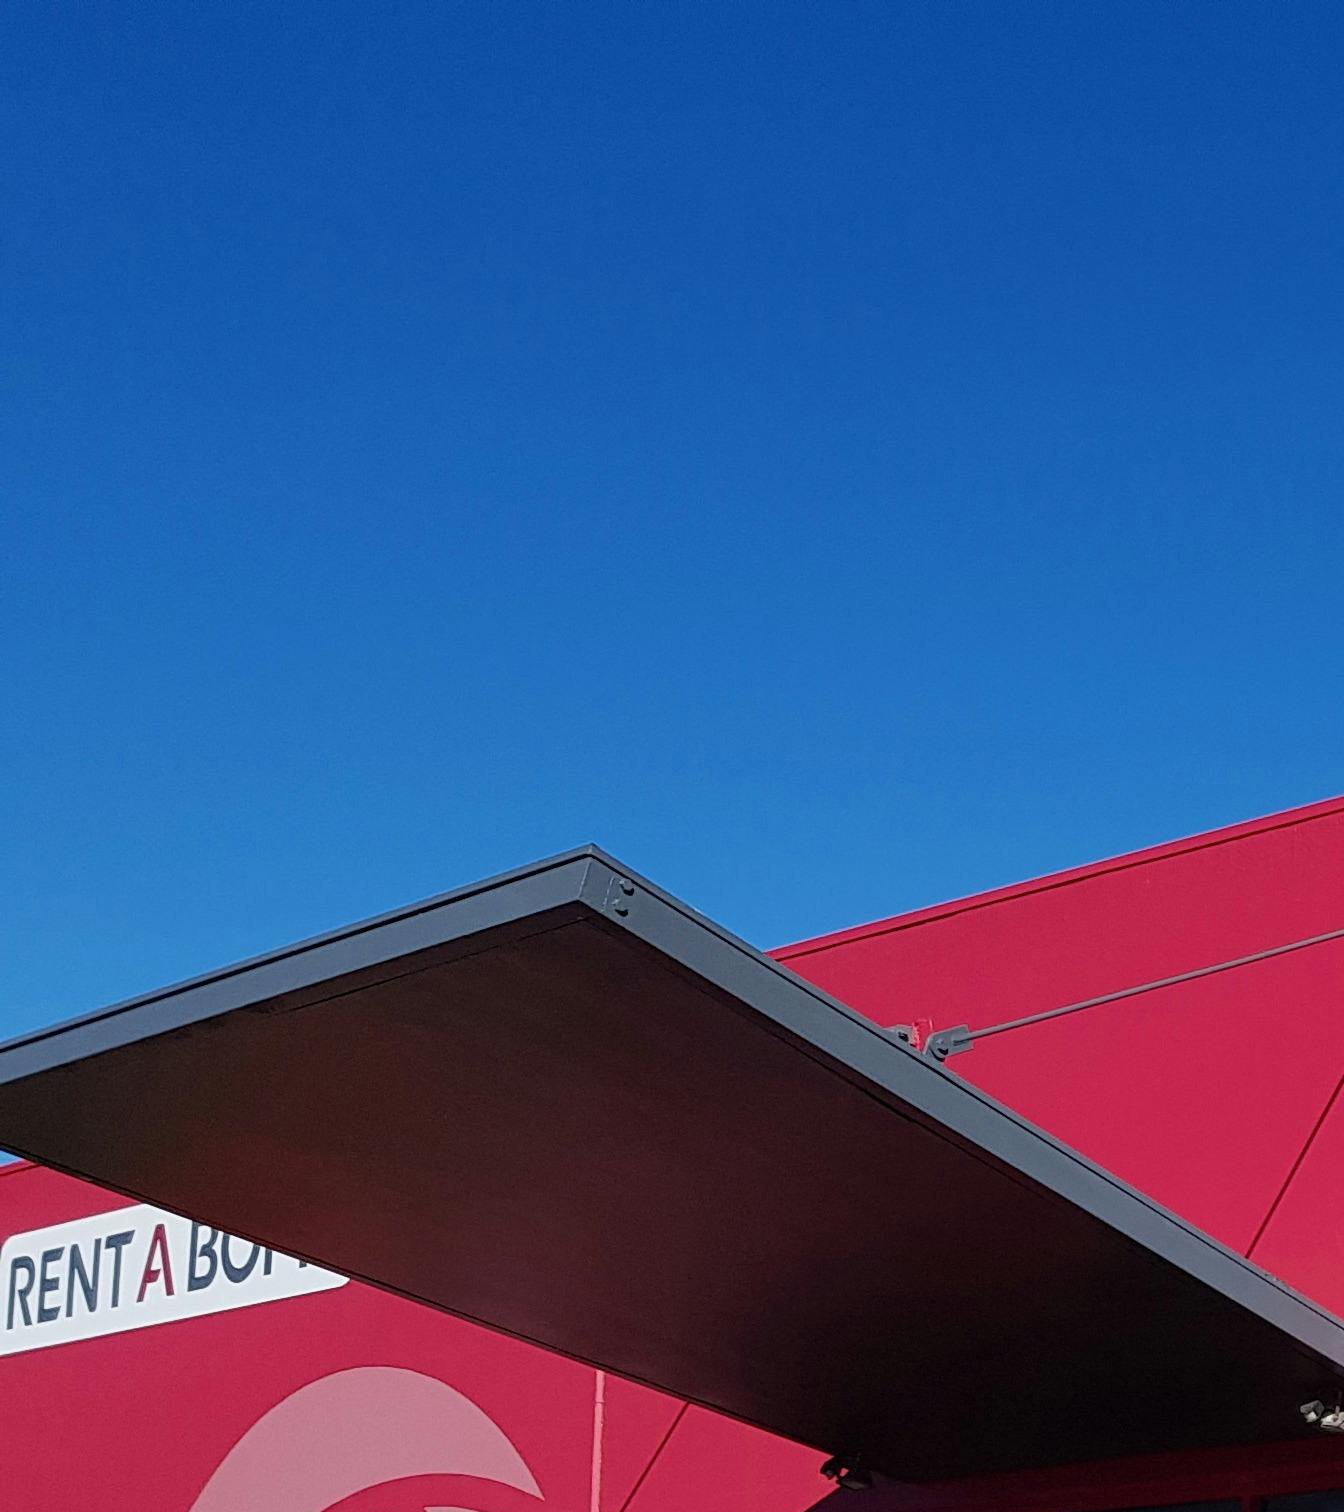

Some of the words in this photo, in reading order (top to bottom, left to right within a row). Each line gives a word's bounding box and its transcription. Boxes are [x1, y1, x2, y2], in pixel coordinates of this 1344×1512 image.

[6, 1229, 136, 1331] RENT
[136, 1223, 175, 1303] A
[187, 1220, 308, 1292] BO
